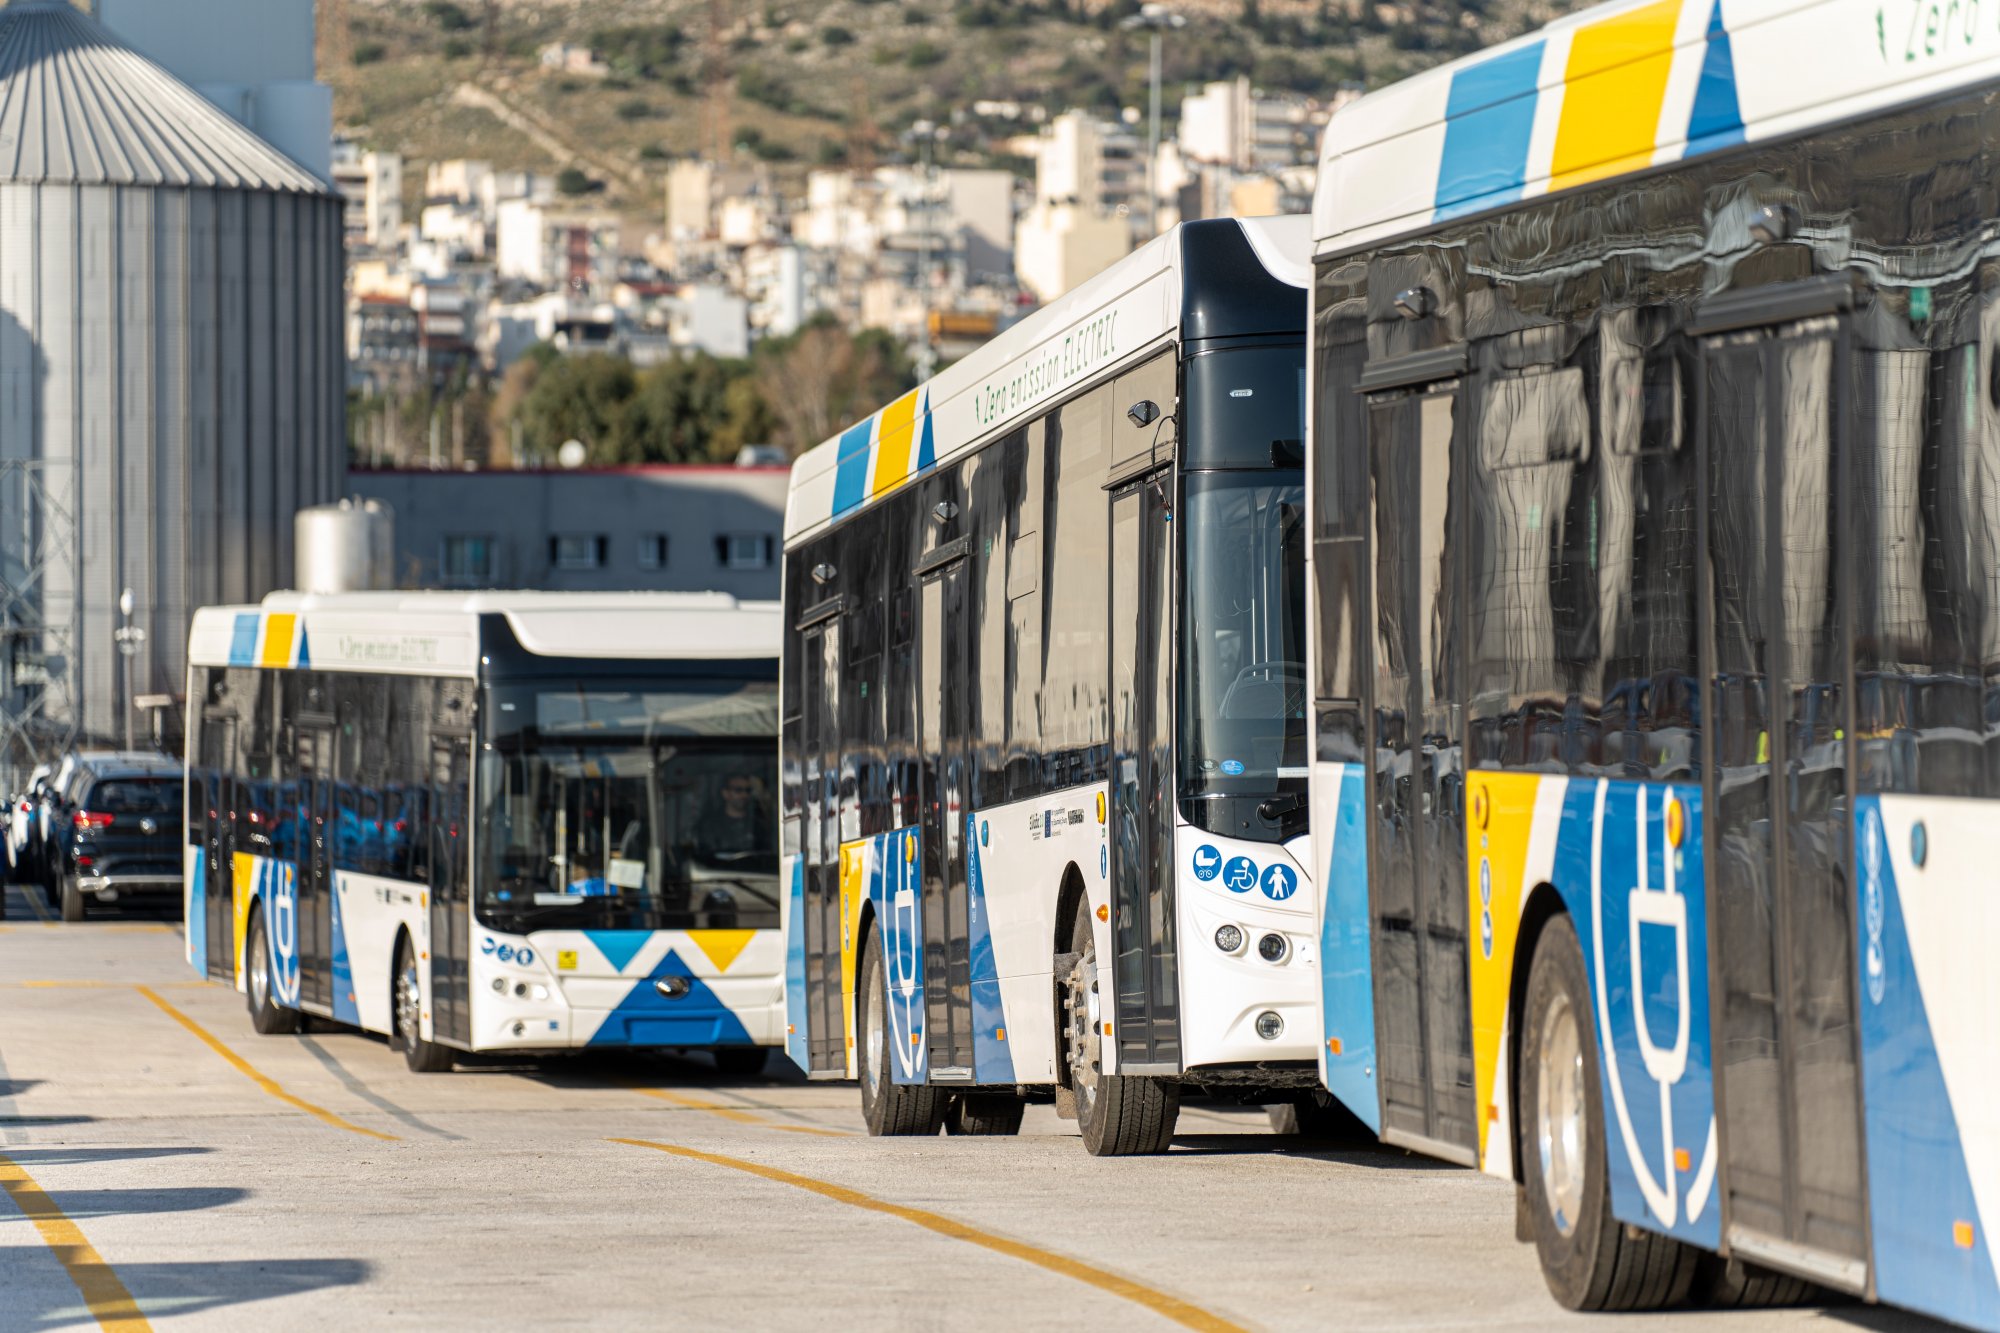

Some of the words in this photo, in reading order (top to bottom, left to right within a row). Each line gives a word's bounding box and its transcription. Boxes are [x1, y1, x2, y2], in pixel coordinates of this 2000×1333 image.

[983, 384, 1006, 425] Zero
[1010, 350, 1059, 409] emission
[1063, 310, 1118, 379] ELECTRIC
